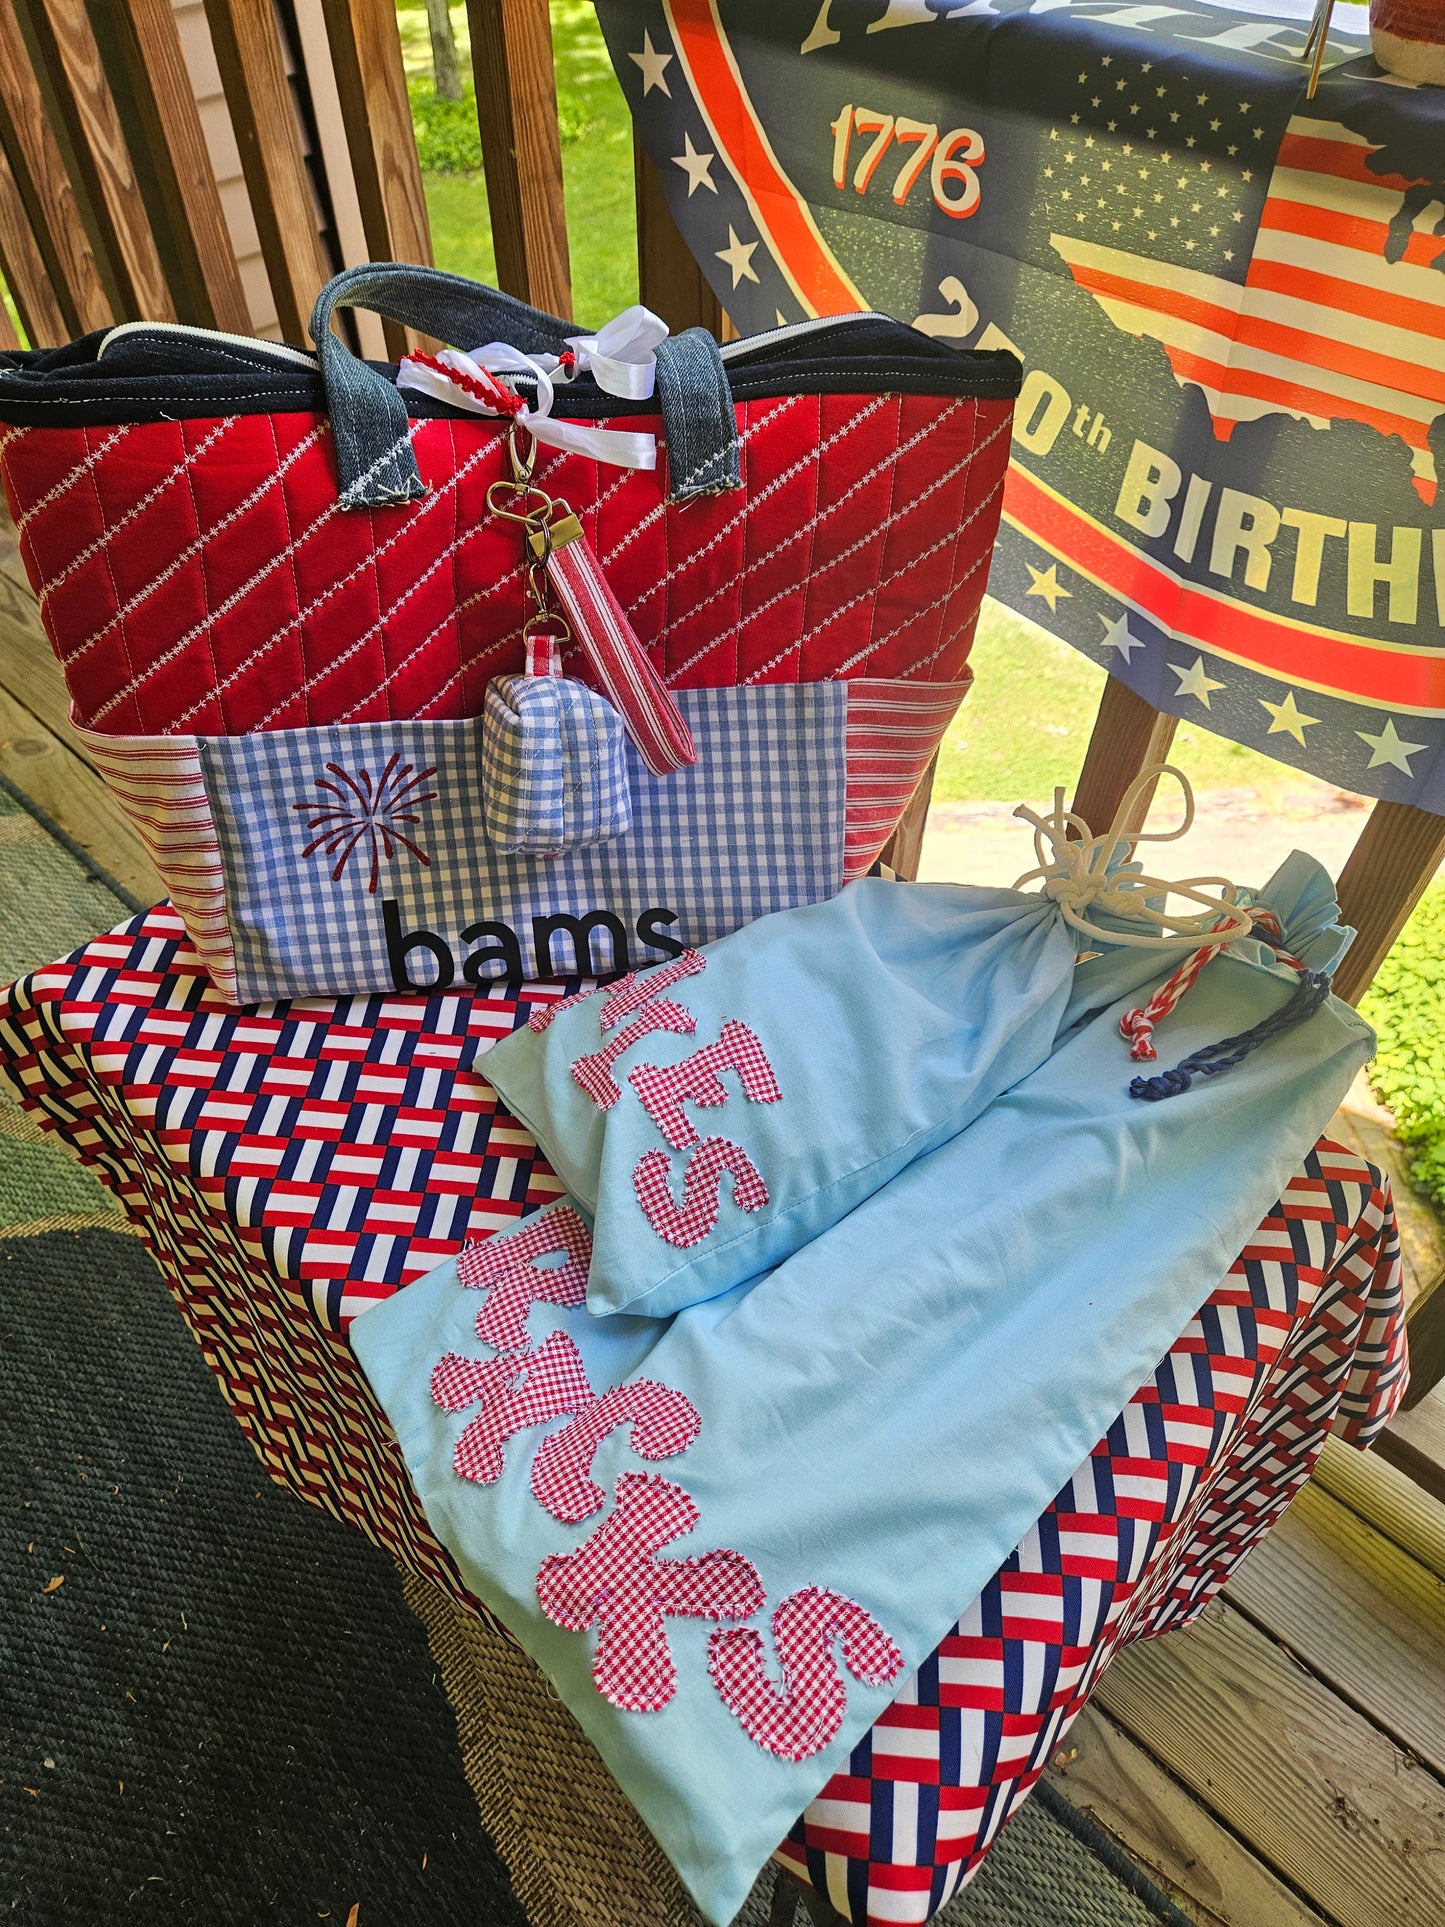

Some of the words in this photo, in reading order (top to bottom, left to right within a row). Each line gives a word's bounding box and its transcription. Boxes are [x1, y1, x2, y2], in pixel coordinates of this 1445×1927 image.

[830, 103, 985, 219] 1776
[911, 275, 1113, 456] 20th
[1114, 438, 1445, 627] BIRTH
[381, 899, 685, 991] bams
[429, 1205, 905, 1762] RACKS
